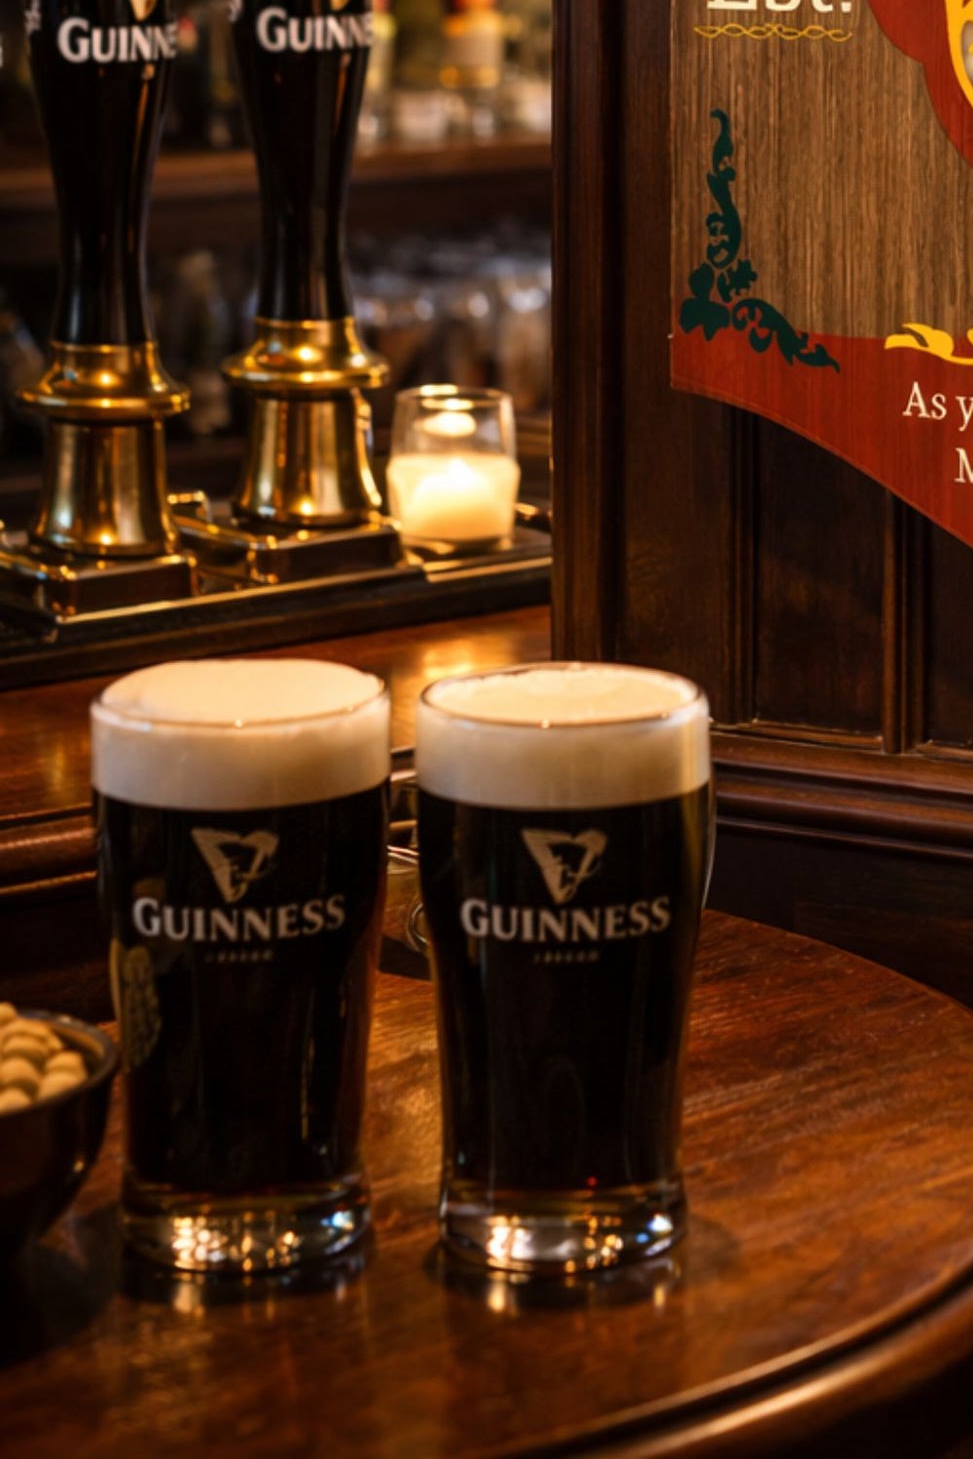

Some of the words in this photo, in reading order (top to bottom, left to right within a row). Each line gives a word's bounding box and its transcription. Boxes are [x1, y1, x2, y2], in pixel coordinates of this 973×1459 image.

[902, 381, 947, 420] As
[132, 895, 346, 942] GUINNESS
[460, 896, 671, 943] GUINNESS
